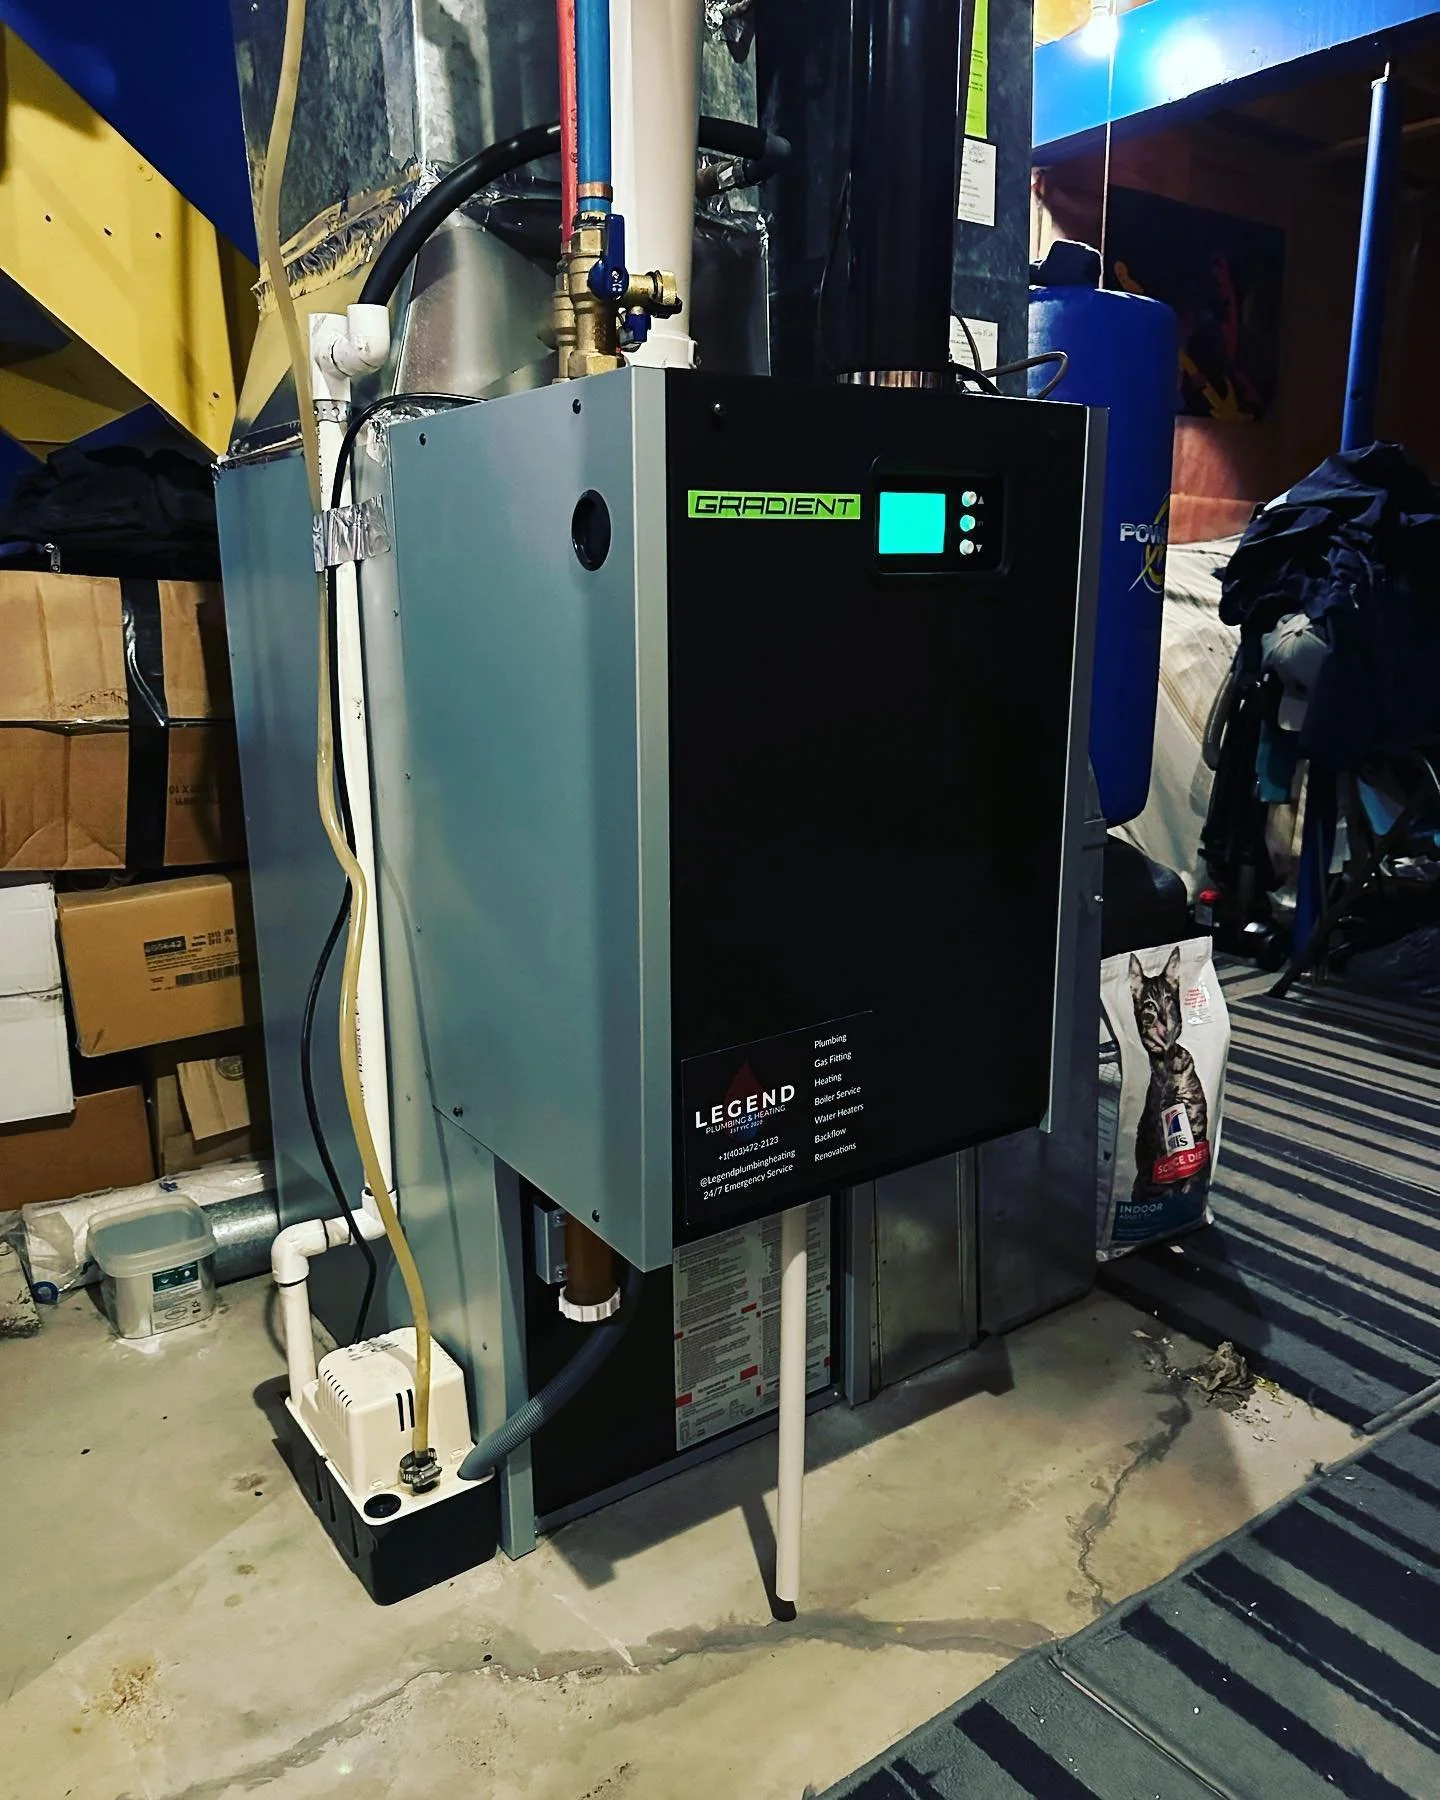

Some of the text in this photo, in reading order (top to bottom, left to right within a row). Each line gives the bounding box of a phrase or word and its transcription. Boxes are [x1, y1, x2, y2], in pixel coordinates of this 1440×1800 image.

[694, 495, 854, 517] GRADIENT
[814, 1034, 847, 1049] Plumbing
[814, 1051, 852, 1068] Gas Fitting
[814, 1073, 842, 1087] Heating
[695, 1084, 795, 1129] LEGEND
[814, 1086, 861, 1106] Boiler Service
[705, 1116, 747, 1135] PLUMBING
[754, 1104, 786, 1119] HEATING
[814, 1103, 864, 1124] Water Heaters
[814, 1127, 847, 1144] Backflow
[718, 1135, 779, 1161] +1(403)472-2123
[814, 1142, 857, 1163] Renovations
[700, 1149, 796, 1188] @Legendplumbingheating
[703, 1164, 794, 1200] 24/7 Emergency Service
[1120, 1202, 1163, 1214] INDOOR
